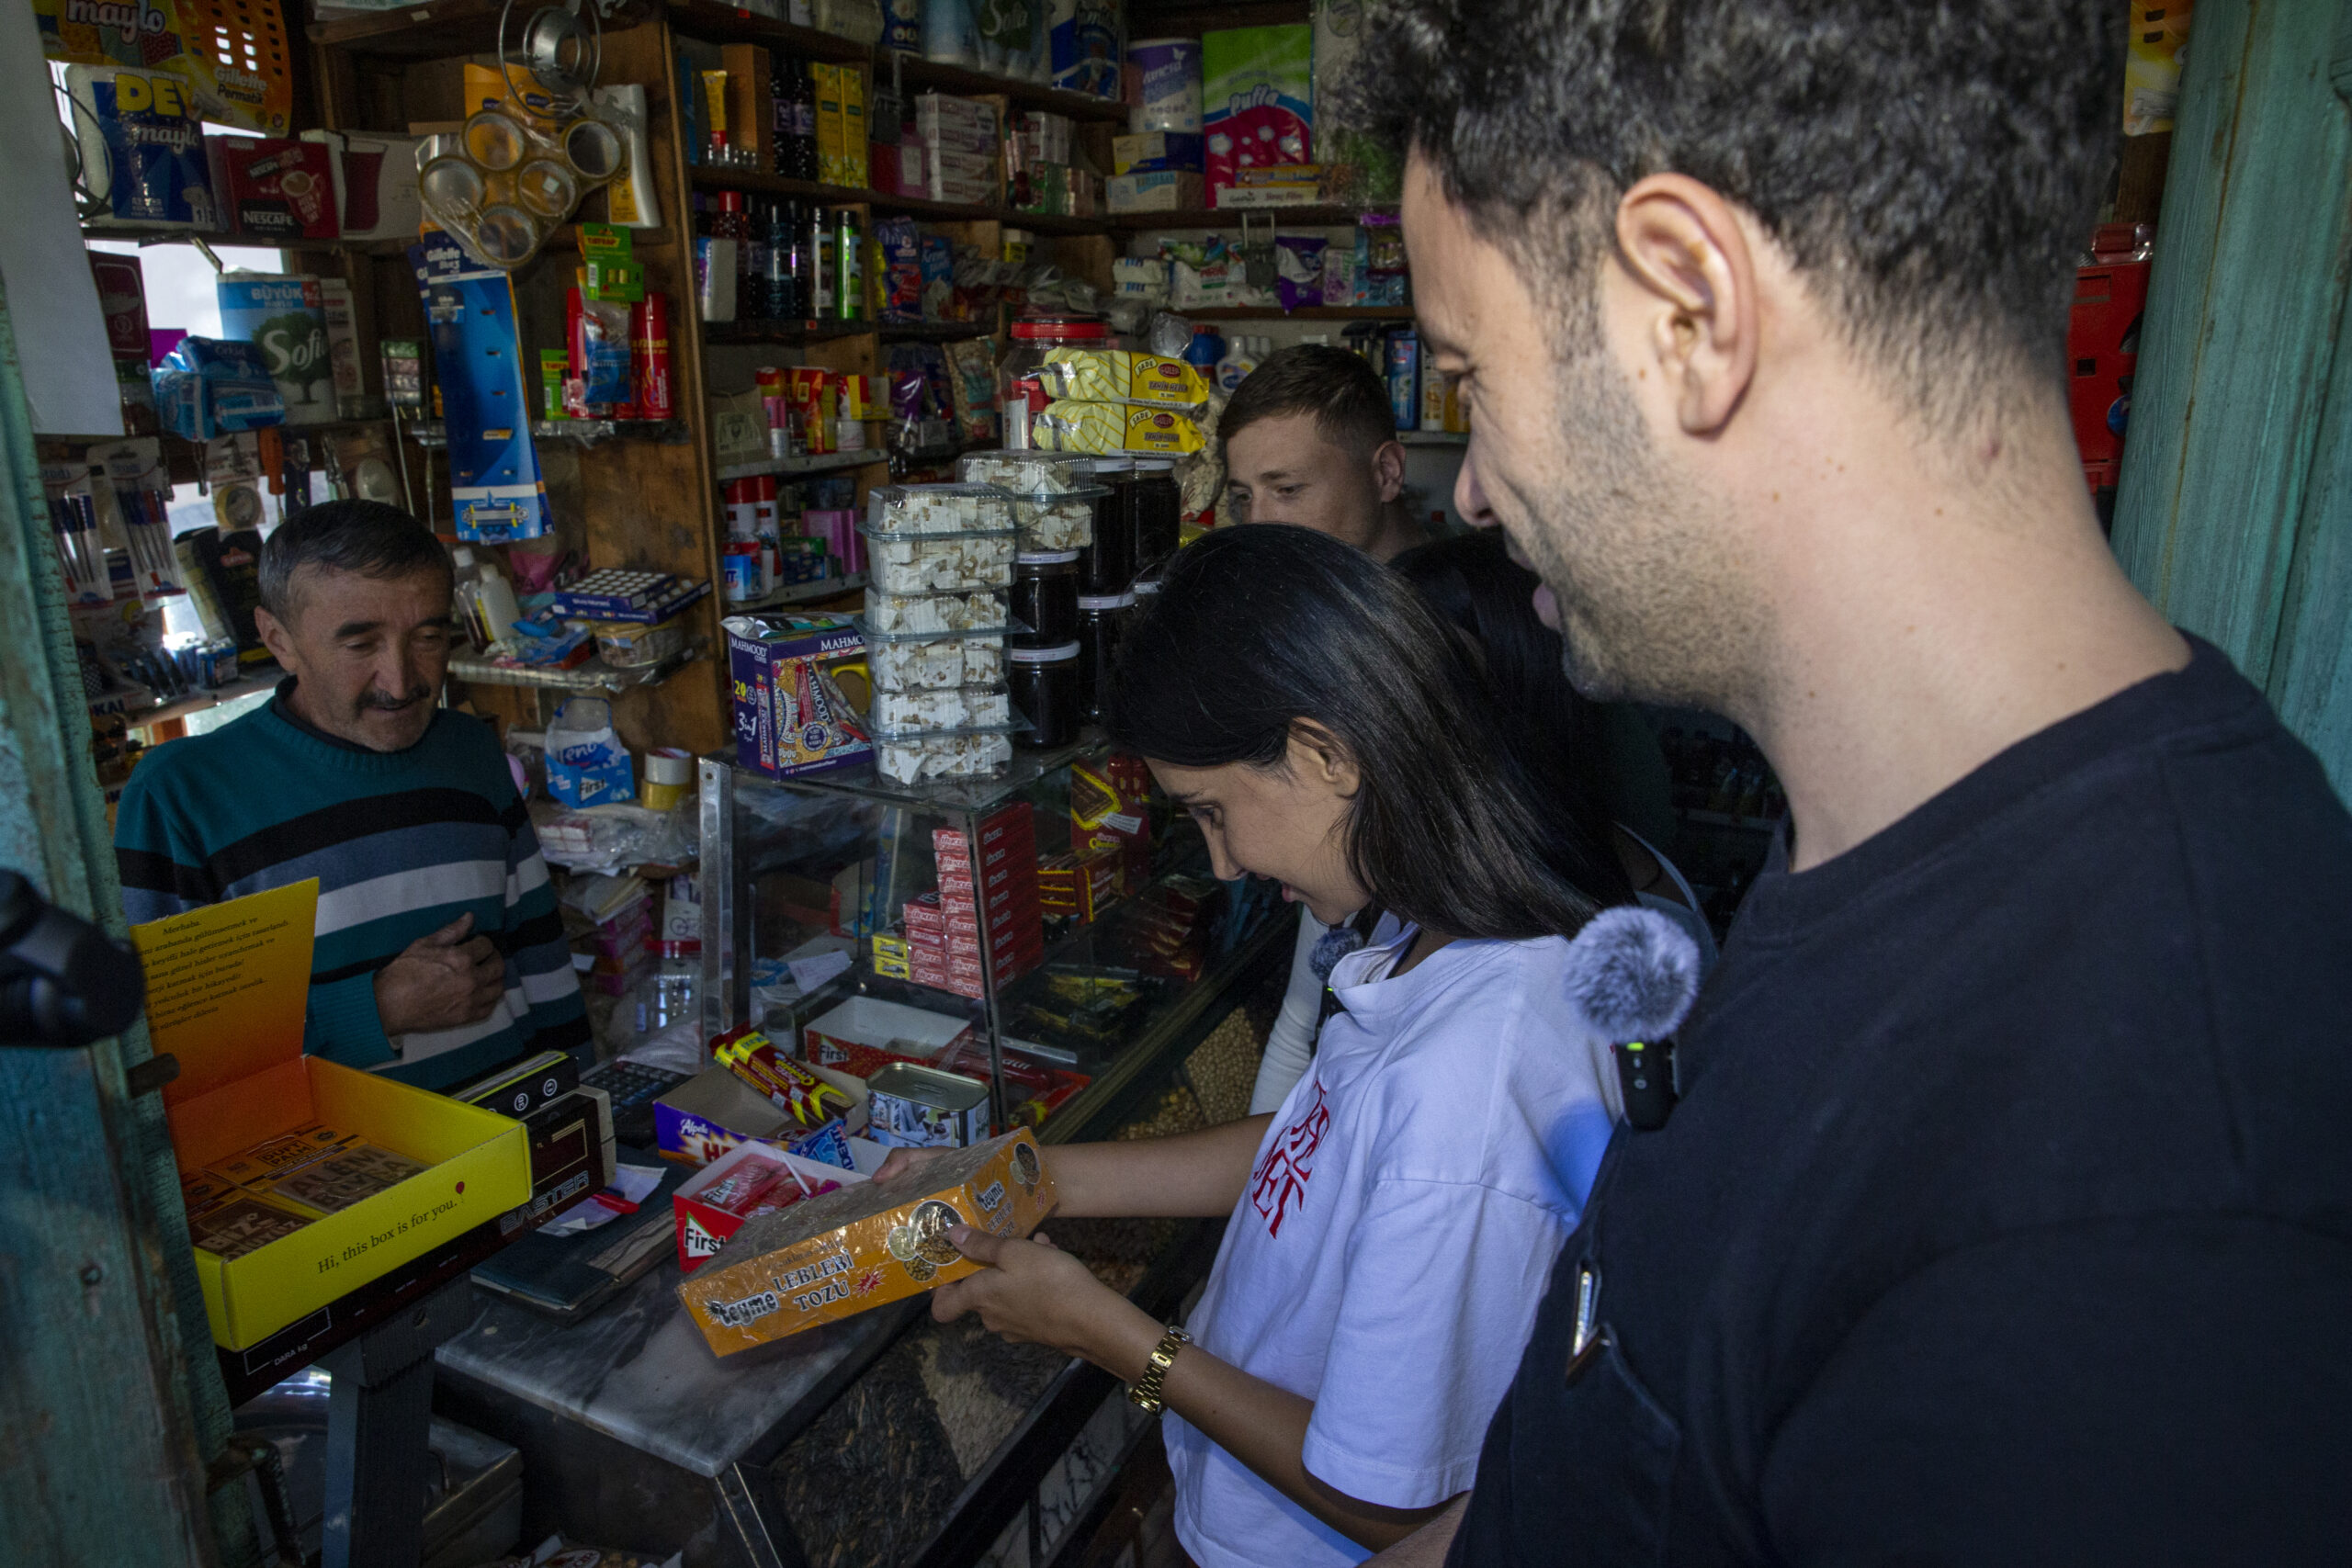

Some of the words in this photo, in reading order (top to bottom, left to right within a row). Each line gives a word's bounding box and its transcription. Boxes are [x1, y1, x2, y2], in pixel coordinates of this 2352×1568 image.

[213, 66, 268, 91] Gillette
[730, 637, 768, 658] MAHMOOD
[820, 635, 865, 652] MAHMO
[734, 680, 747, 698] 20
[819, 1043, 849, 1062] First
[830, 1128, 855, 1171] IDENT
[317, 1255, 340, 1274] Hi,
[342, 1241, 368, 1262] this
[369, 1228, 395, 1248] box
[397, 1221, 409, 1235] is
[411, 1211, 429, 1228] for
[431, 1198, 458, 1222] you.
[684, 1227, 727, 1253] First
[771, 1247, 854, 1292] LEBLEBİ
[793, 1280, 851, 1313] TOZU
